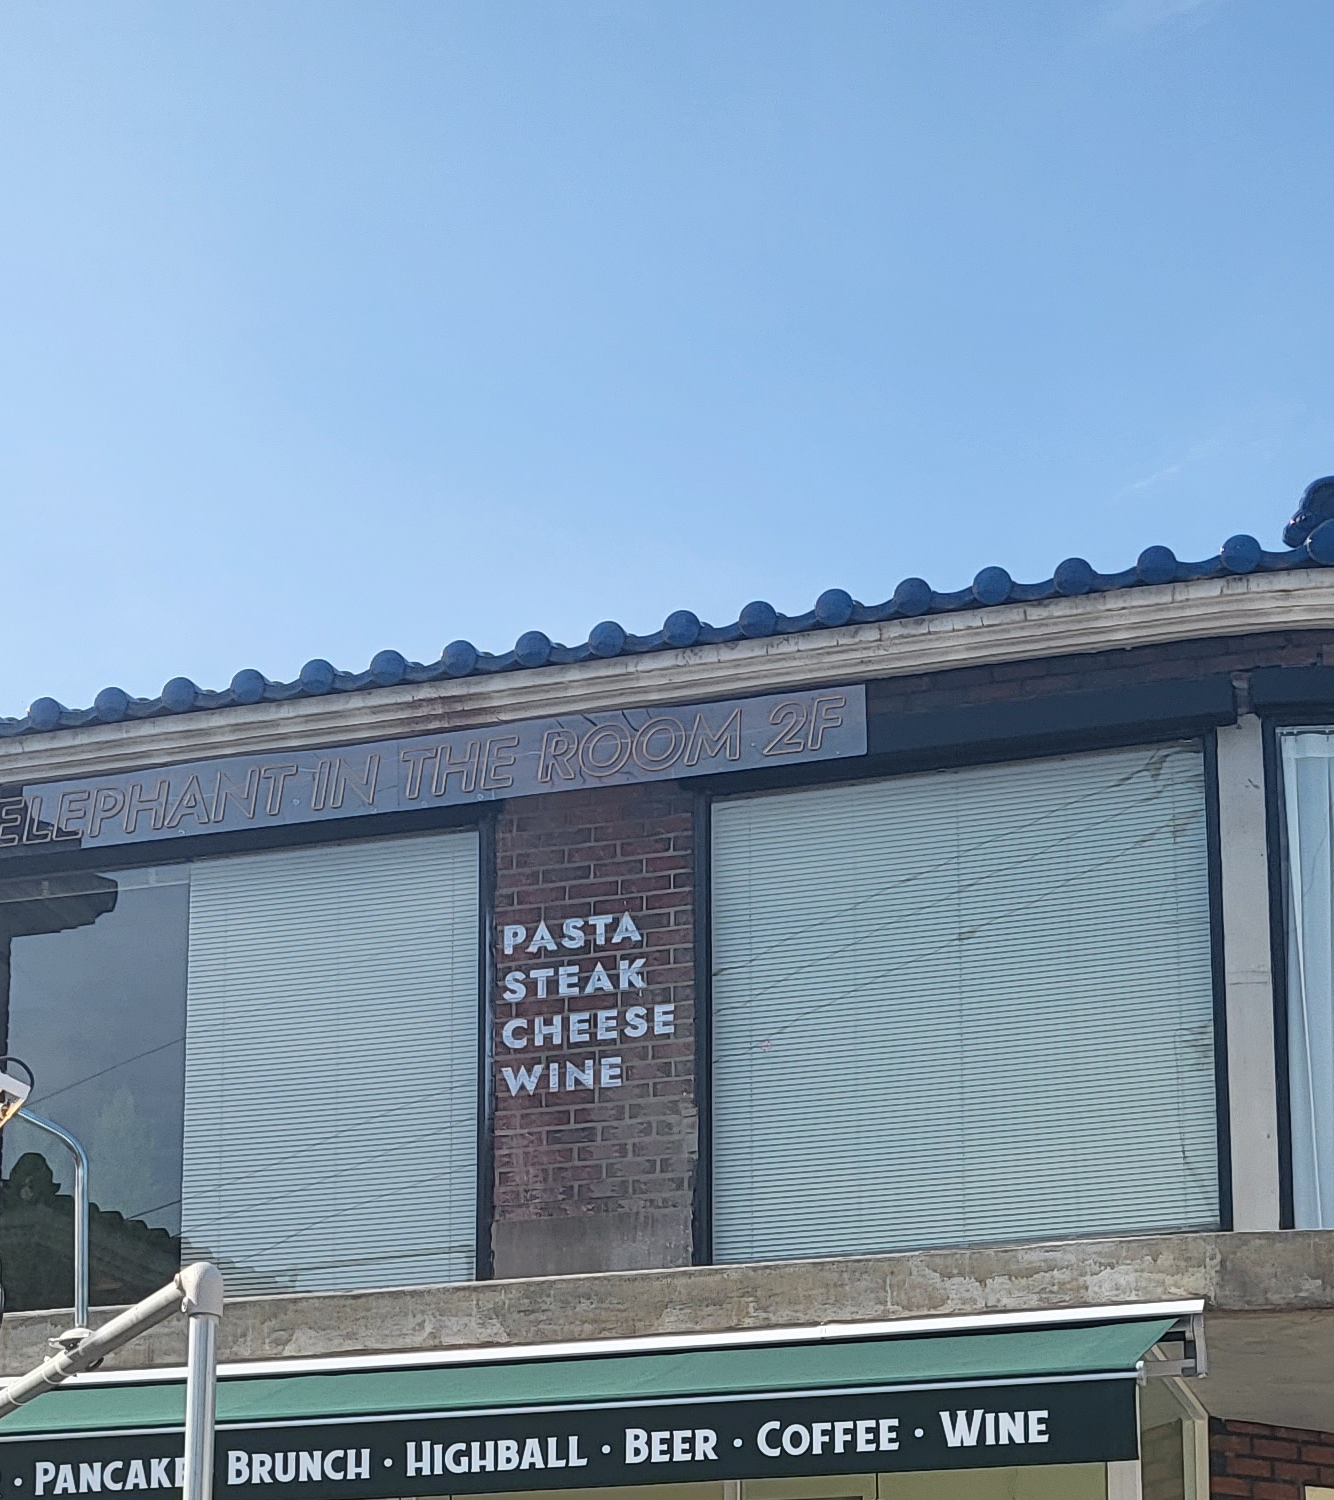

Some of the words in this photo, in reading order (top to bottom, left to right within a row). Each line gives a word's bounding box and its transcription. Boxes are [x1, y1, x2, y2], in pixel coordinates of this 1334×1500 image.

[312, 753, 379, 811] IN
[401, 735, 520, 800] THE
[538, 708, 743, 783] ROOM
[763, 696, 847, 756] 2F
[503, 911, 642, 955] PASTA
[502, 958, 648, 1003] STEAK
[502, 1003, 675, 1049] CHEESE
[501, 1057, 622, 1097] WINE
[227, 1447, 372, 1486] BRUNCH
[405, 1435, 589, 1478] HIGHBALL
[624, 1427, 719, 1464] BEER
[756, 1417, 901, 1458] COFFEE
[938, 1408, 1050, 1448] WINE
